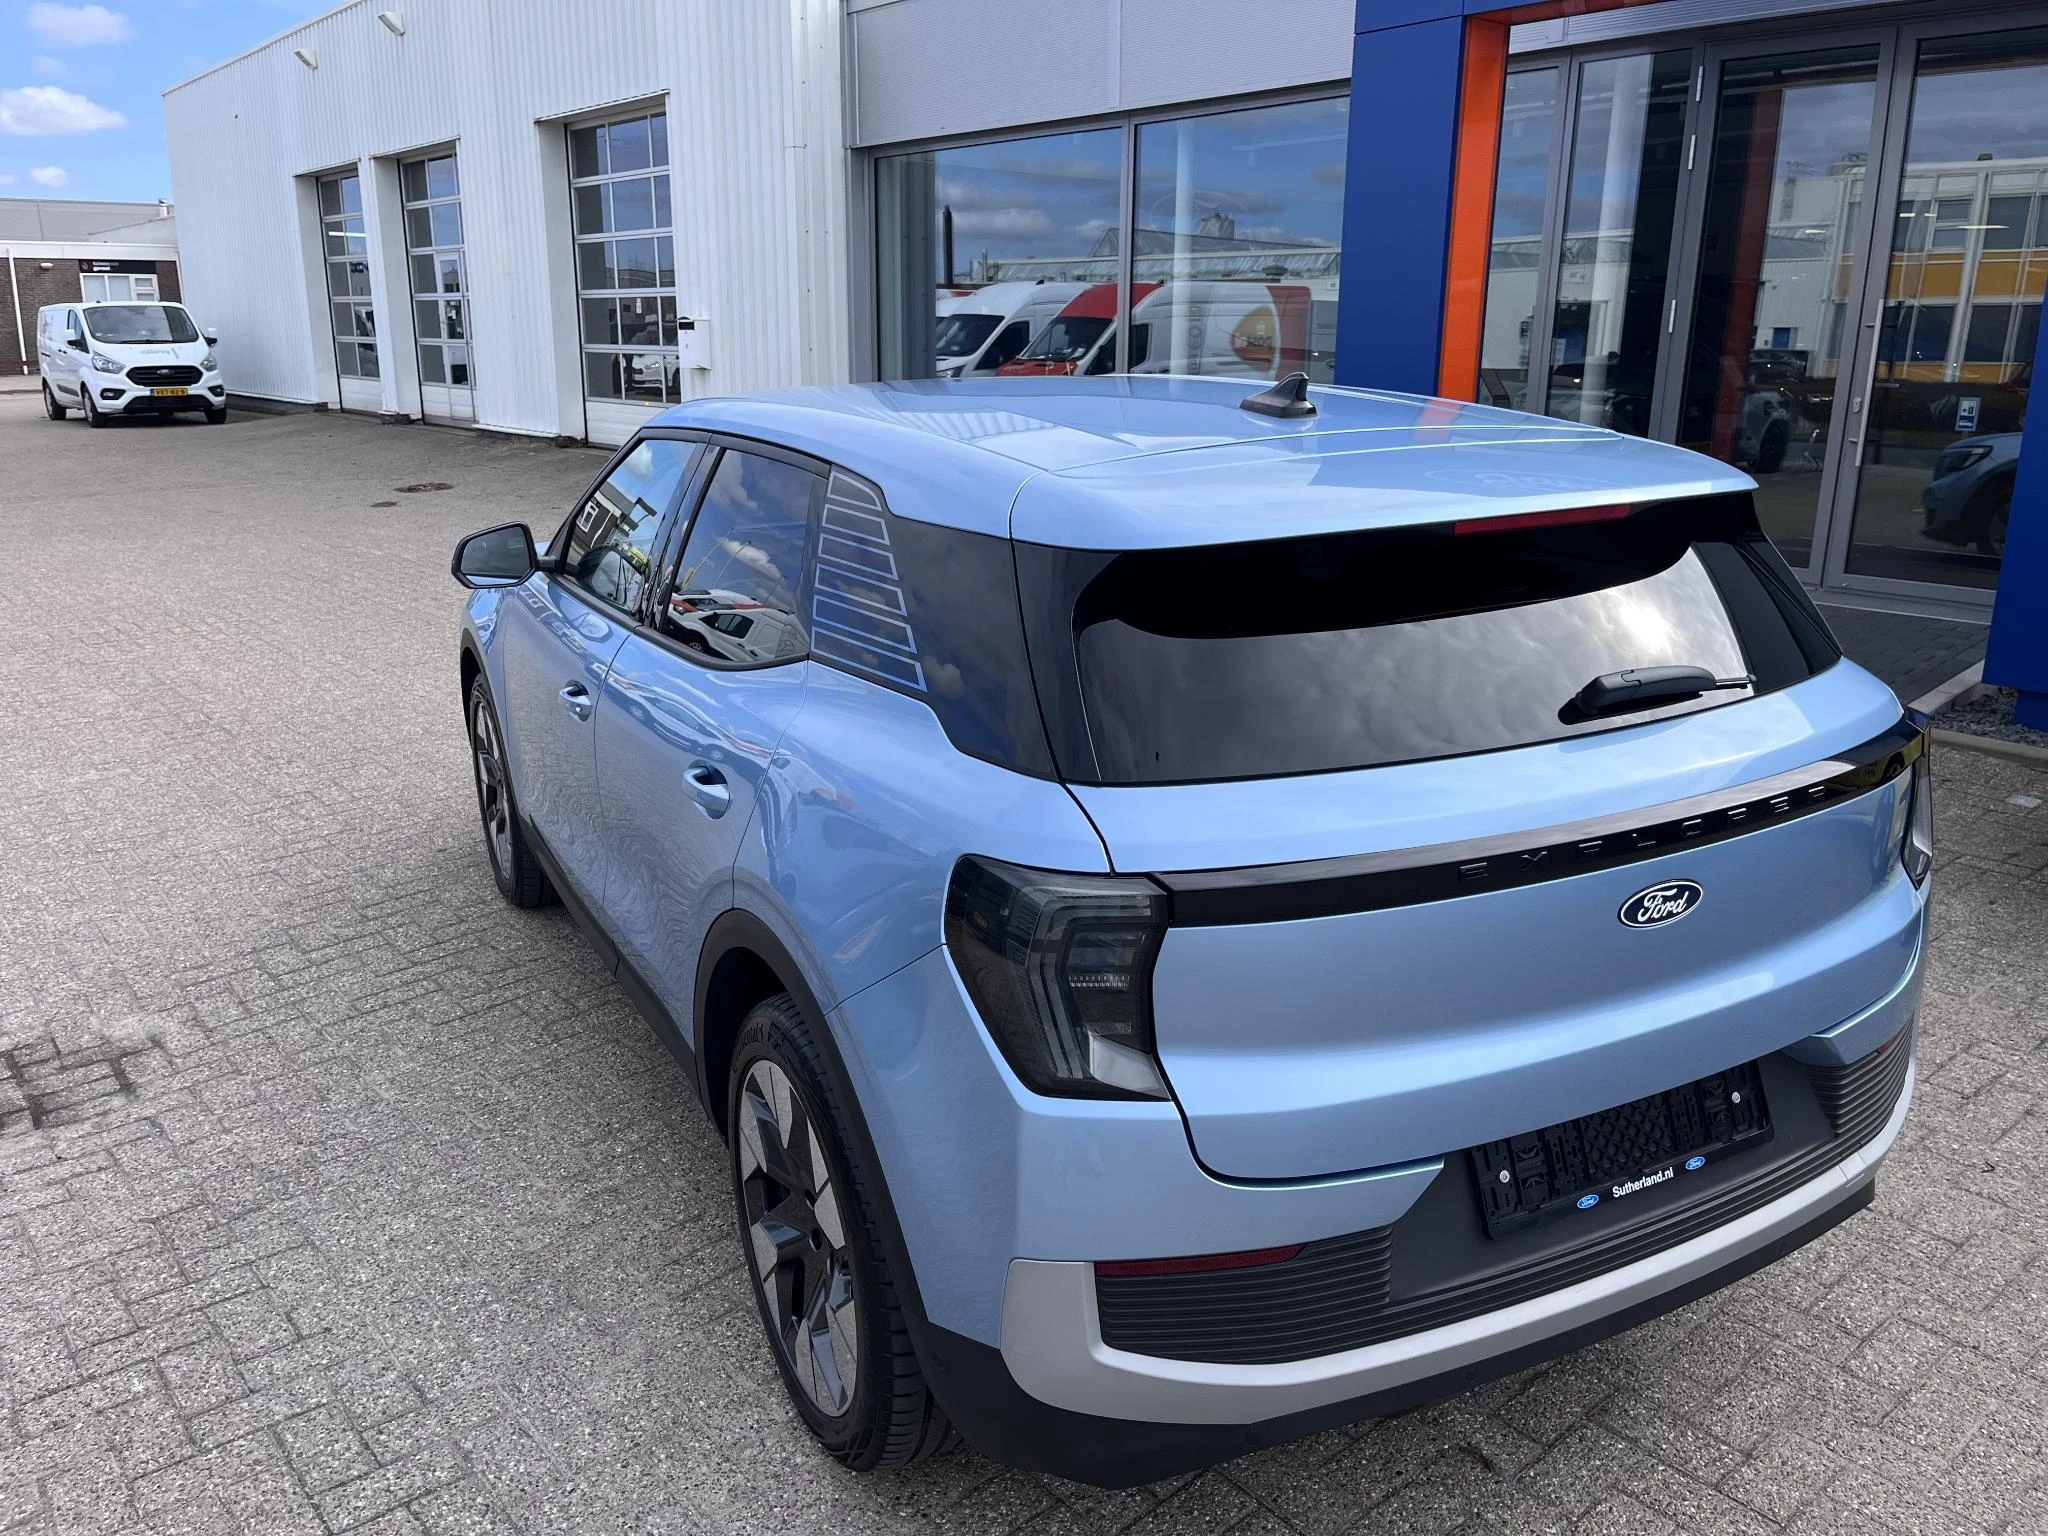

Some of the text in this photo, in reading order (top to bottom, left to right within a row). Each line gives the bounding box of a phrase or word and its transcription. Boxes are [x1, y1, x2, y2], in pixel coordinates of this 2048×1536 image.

[1457, 786, 1826, 884] EXPLORER
[1636, 887, 1690, 922] Ford
[1612, 1166, 1674, 1198] Sutherland.nl
[1580, 1195, 1596, 1207] Ford
